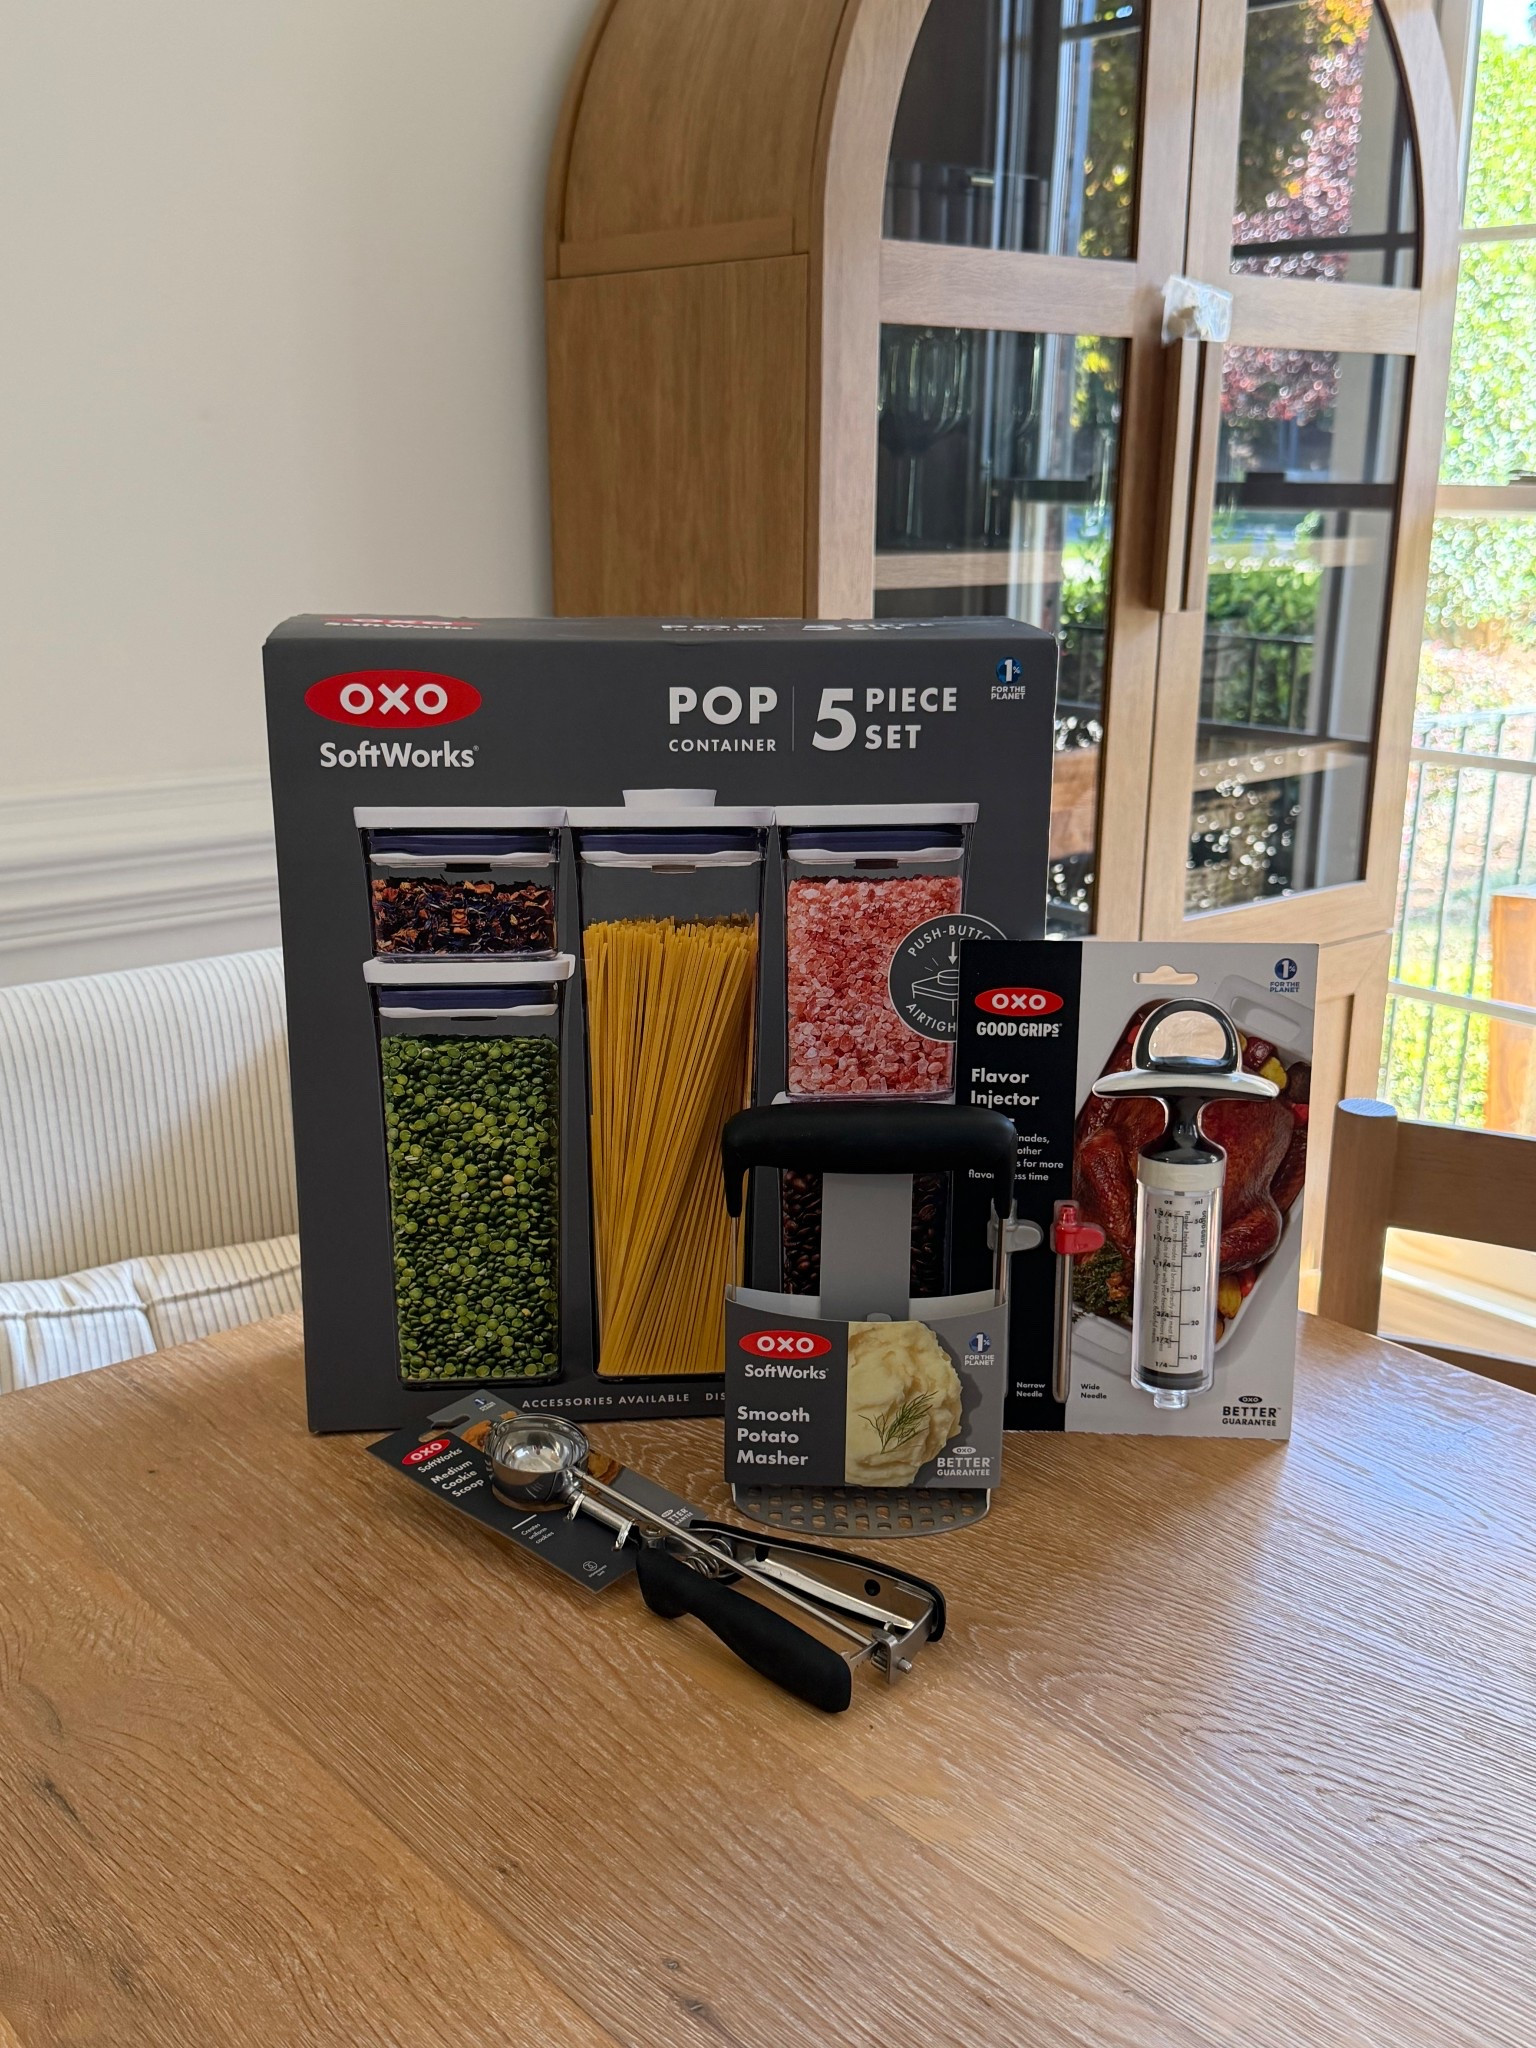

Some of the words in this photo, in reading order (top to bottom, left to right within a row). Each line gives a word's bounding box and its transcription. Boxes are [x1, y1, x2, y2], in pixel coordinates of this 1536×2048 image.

[339, 683, 448, 716] OXO
[991, 692, 1026, 700] PLANET
[669, 685, 778, 726] POP
[812, 688, 857, 751] 5
[866, 687, 958, 713] PIECE
[864, 724, 922, 750] SET
[669, 739, 777, 753] CONTAINER
[908, 925, 991, 957] PUSH-BUTT
[991, 993, 1047, 1011] OXO
[905, 1003, 956, 1033] AIRTIGH
[976, 1022, 1017, 1036] GOOD
[1019, 1023, 1060, 1038] GRIPS
[971, 1068, 1030, 1084] Flavor
[970, 1090, 1040, 1109] Injector
[1016, 1133, 1050, 1144] inades,
[1017, 1146, 1042, 1156] other
[1023, 1158, 1037, 1168] for
[1039, 1161, 1064, 1169] more
[1028, 1172, 1049, 1181] time
[757, 1335, 815, 1353] OXO
[744, 1364, 827, 1380] SoftWorks
[522, 1396, 613, 1408] ACCESSORIES
[618, 1393, 690, 1404] AVAILABLE
[706, 1392, 725, 1401] DIS
[1016, 1390, 1043, 1398] Needle
[1080, 1392, 1107, 1400] Needle
[737, 1406, 811, 1423] Smooth
[1222, 1406, 1277, 1418] BETTER
[1222, 1417, 1277, 1427] GUARANTEE
[737, 1428, 800, 1444] Potato
[410, 1442, 443, 1461] OXO
[737, 1449, 809, 1466] Masher
[417, 1448, 464, 1474] SoftWorks
[937, 1457, 991, 1468] BETTER
[430, 1460, 473, 1485] Medium
[441, 1469, 478, 1490] Cookie
[451, 1478, 485, 1498] Scoop
[667, 1508, 689, 1522] TTER
